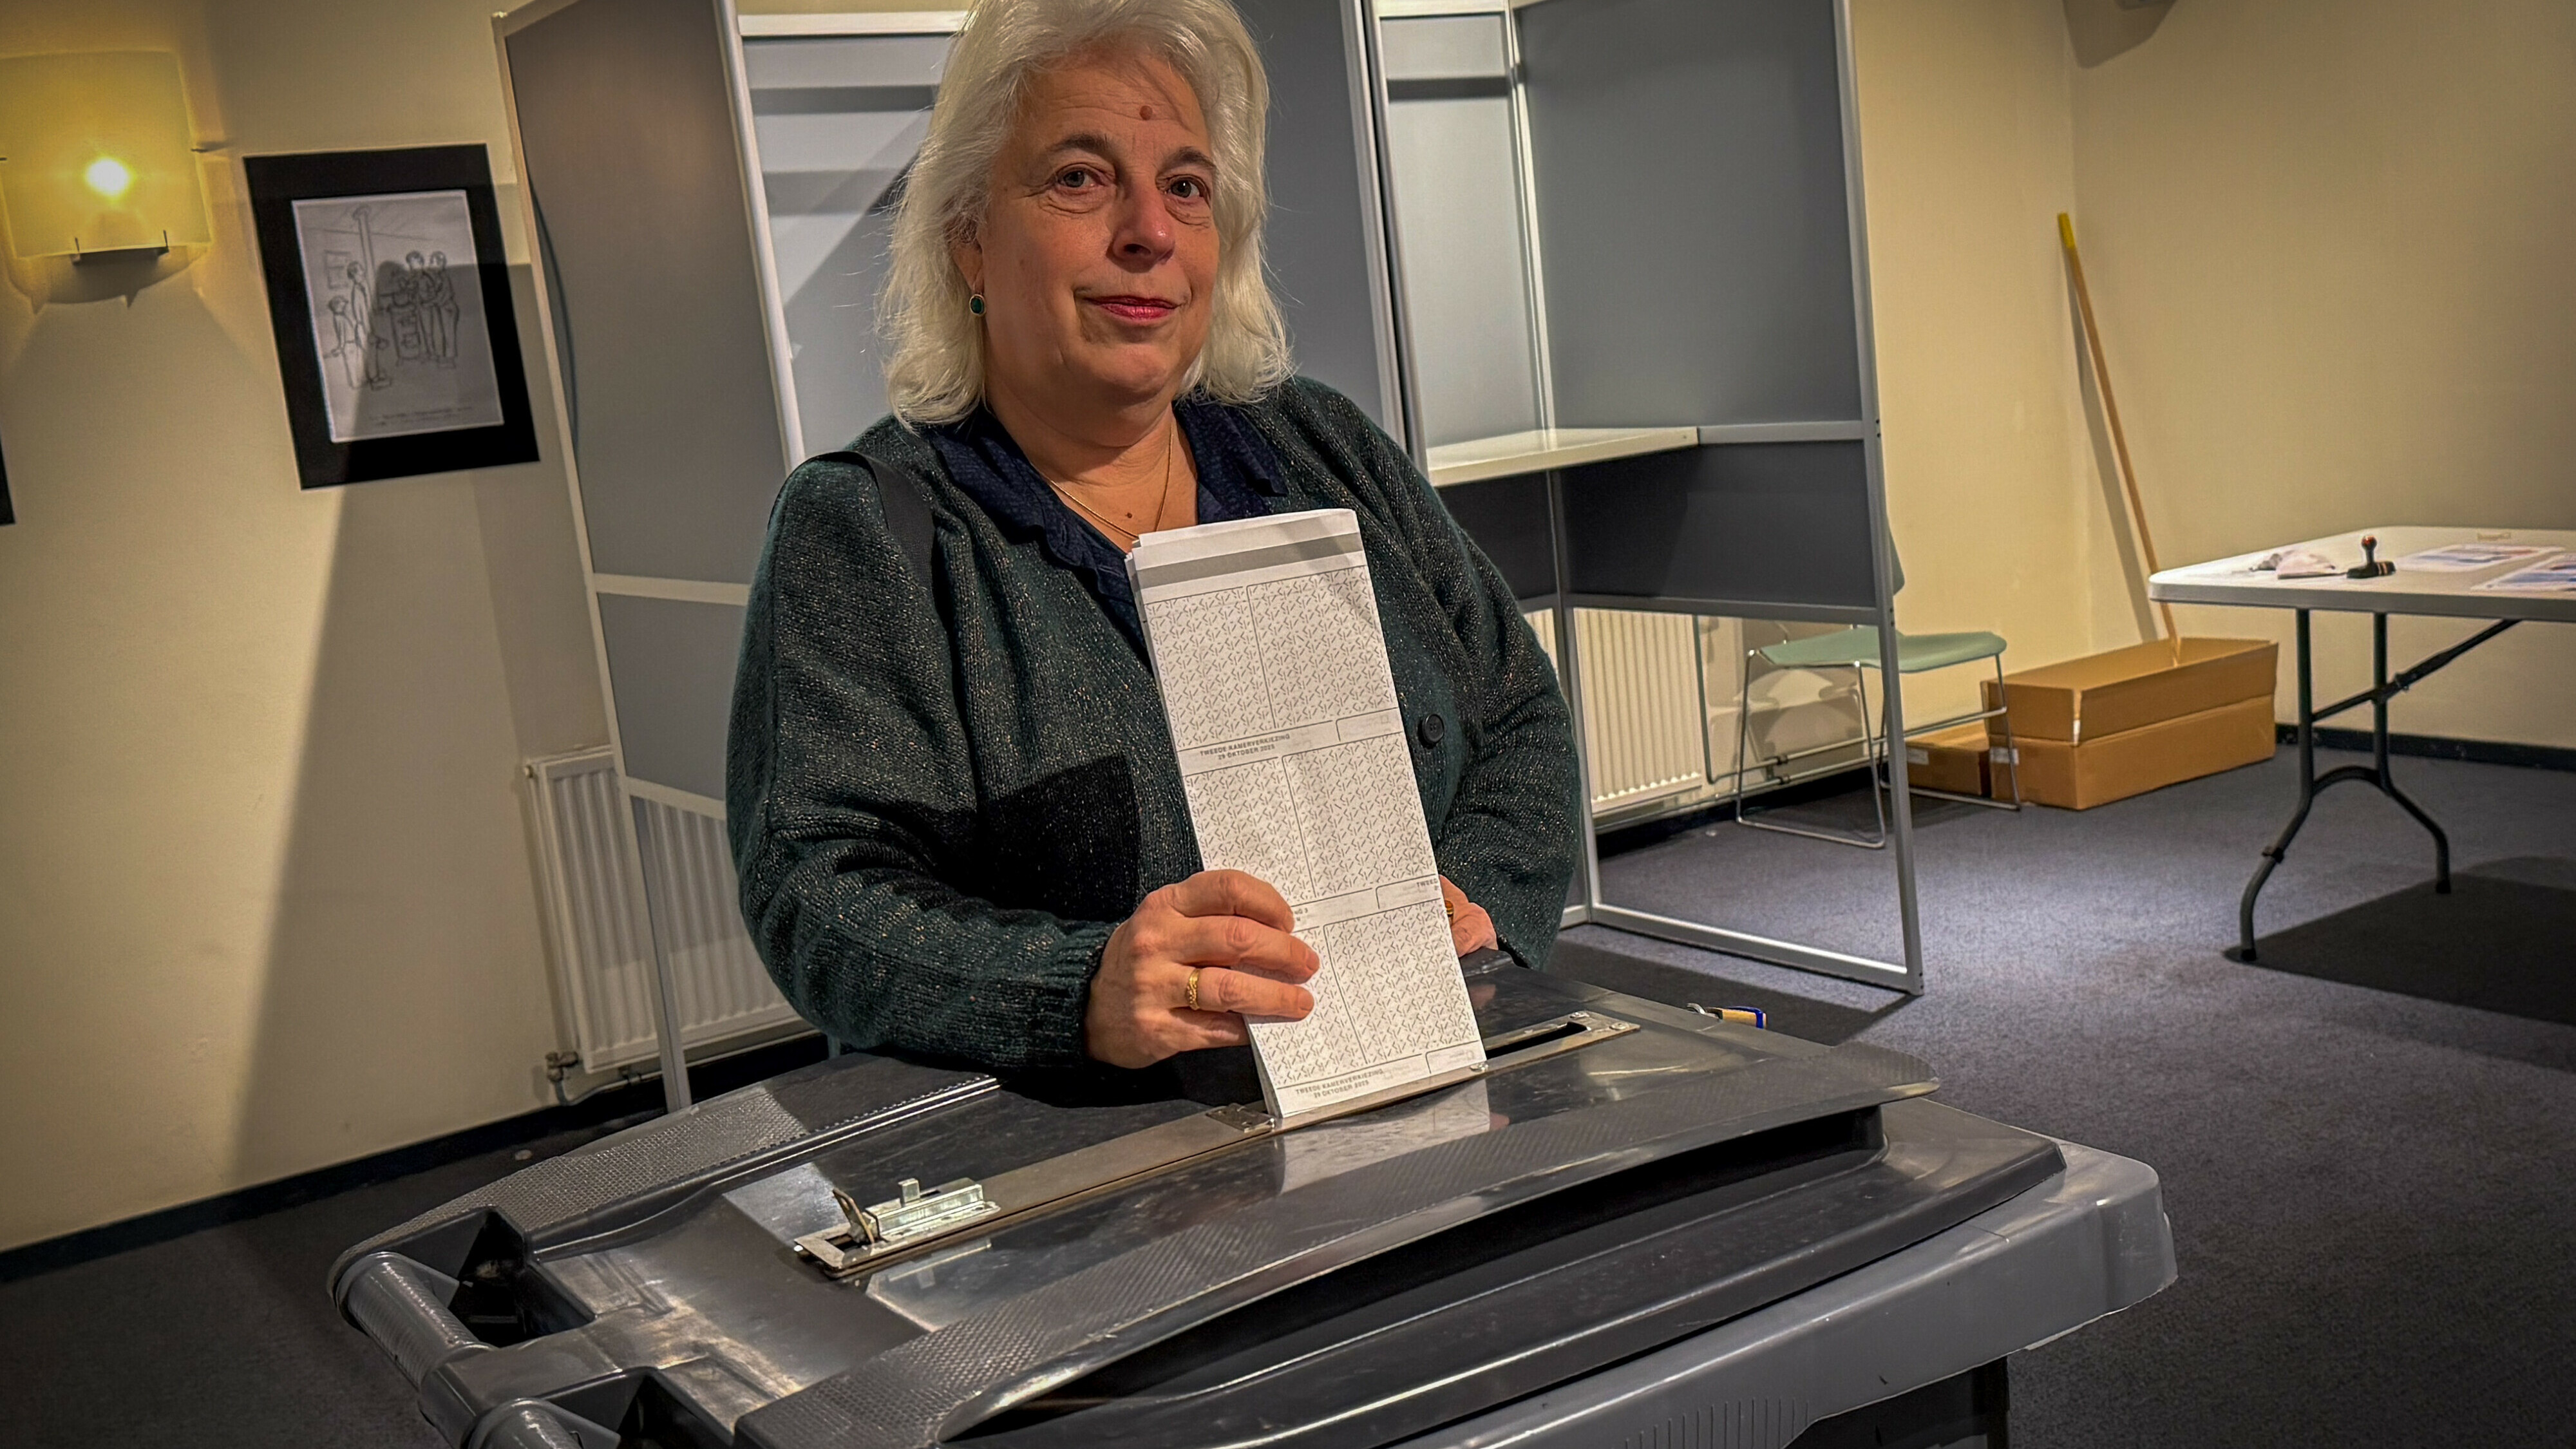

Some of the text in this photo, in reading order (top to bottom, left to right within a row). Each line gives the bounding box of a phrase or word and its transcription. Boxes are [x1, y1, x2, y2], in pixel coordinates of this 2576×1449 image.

[1200, 734, 1290, 756] TWEEDE KAMERVERKIEZING
[1227, 748, 1258, 758] OKTOBER
[1322, 1085, 1353, 1096] OKTOBER
